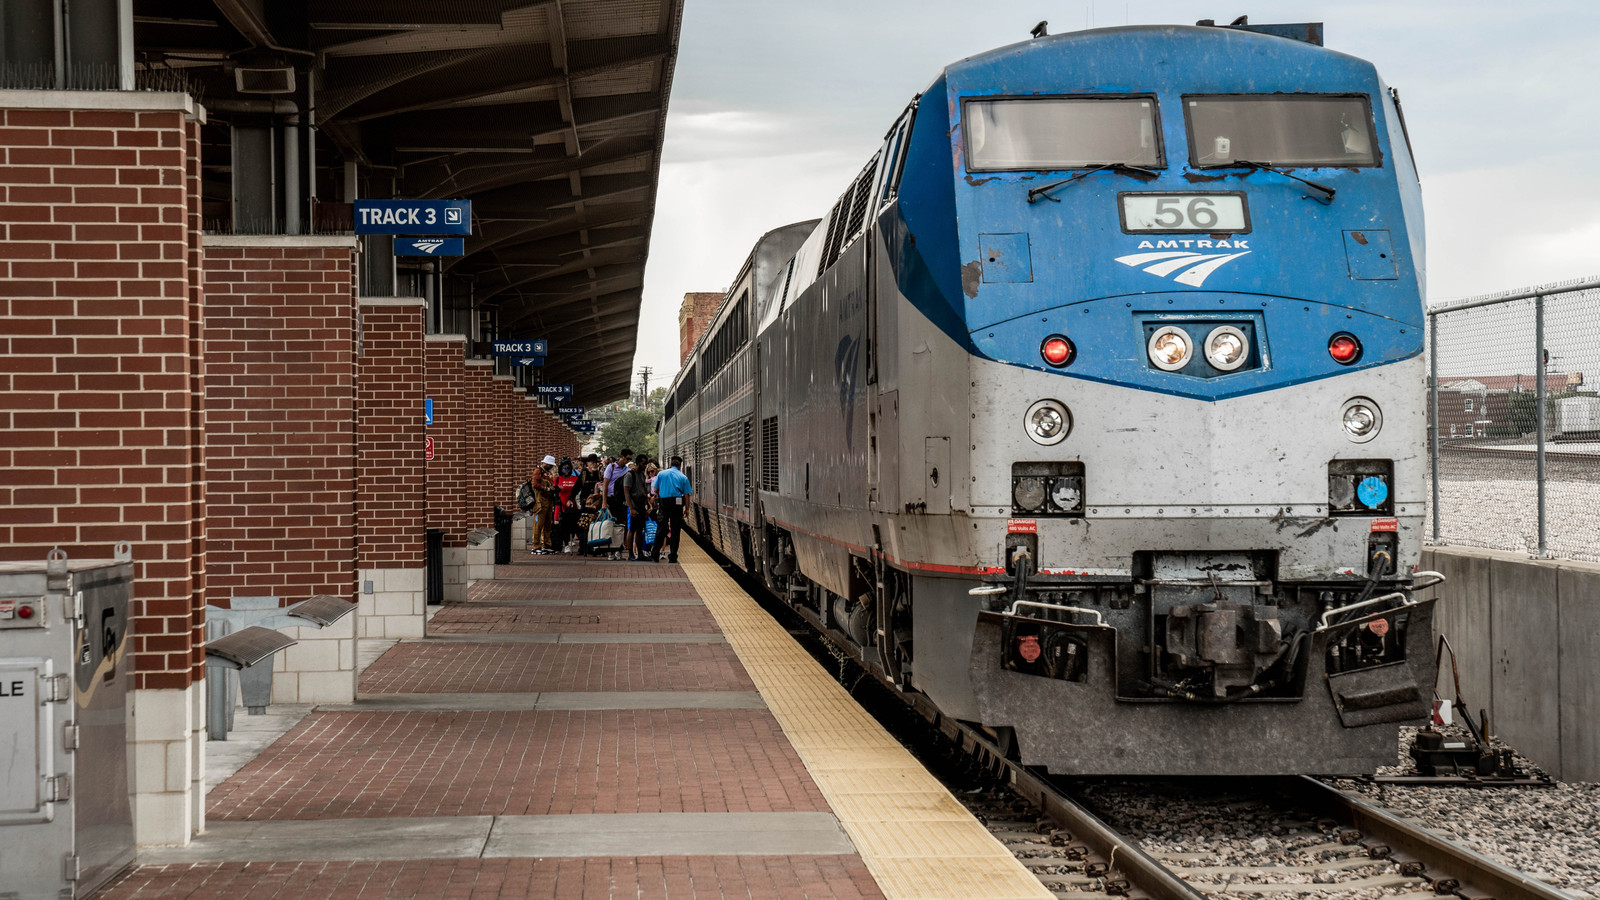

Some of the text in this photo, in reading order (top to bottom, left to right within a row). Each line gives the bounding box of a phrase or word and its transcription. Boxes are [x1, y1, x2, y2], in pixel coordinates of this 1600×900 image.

[359, 208, 436, 224] TRACK 3
[1155, 197, 1218, 228] 56
[1137, 240, 1249, 249] AMTRAK
[494, 343, 532, 352] TRACK 3
